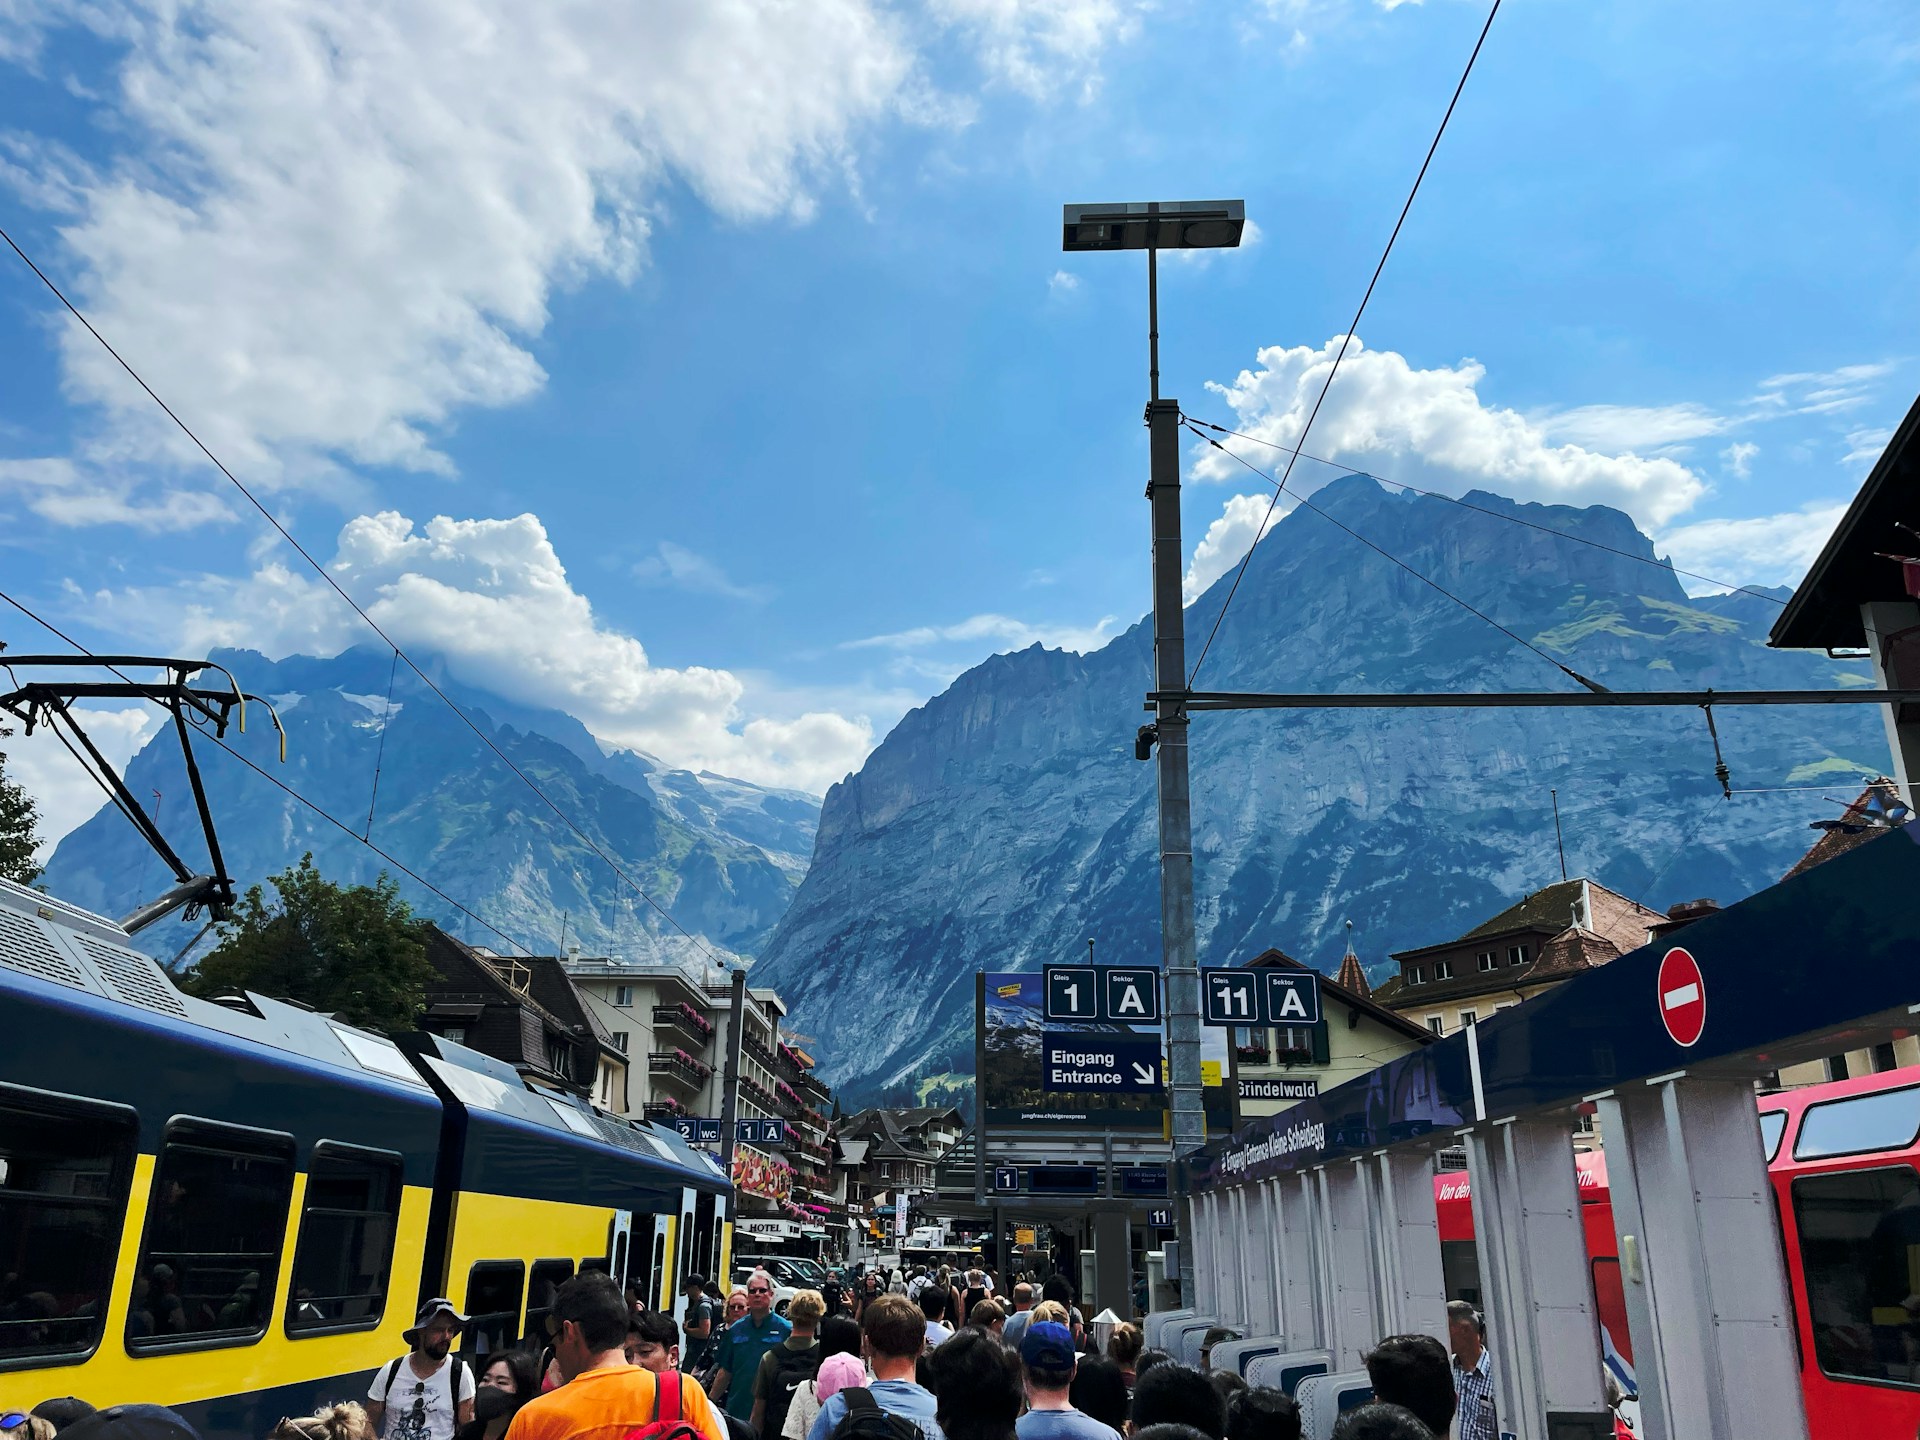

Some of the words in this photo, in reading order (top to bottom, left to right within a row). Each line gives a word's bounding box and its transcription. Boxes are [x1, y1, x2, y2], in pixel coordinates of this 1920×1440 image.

[1272, 978, 1295, 986] Sektor
[1064, 983, 1078, 1012] 1
[1118, 985, 1146, 1014] A
[1216, 986, 1248, 1016] 11
[1279, 988, 1308, 1017] A
[1051, 1050, 1115, 1068] Eingang
[1051, 1069, 1123, 1084] Entrance
[1238, 1081, 1316, 1098] Grindelwald
[1021, 1112, 1087, 1120] jungfrau.ch/eigerexpress
[681, 1125, 690, 1139] 2
[701, 1130, 717, 1139] WC
[744, 1126, 752, 1139] 1
[766, 1126, 778, 1139] A
[1268, 1131, 1288, 1158] Kleine
[1287, 1119, 1325, 1151] Scheidegg
[1003, 1173, 1011, 1187] 1
[1438, 1183, 1455, 1201] Von
[1455, 1181, 1471, 1199] den
[1153, 1210, 1167, 1224] 11
[750, 1223, 781, 1232] HOTEL
